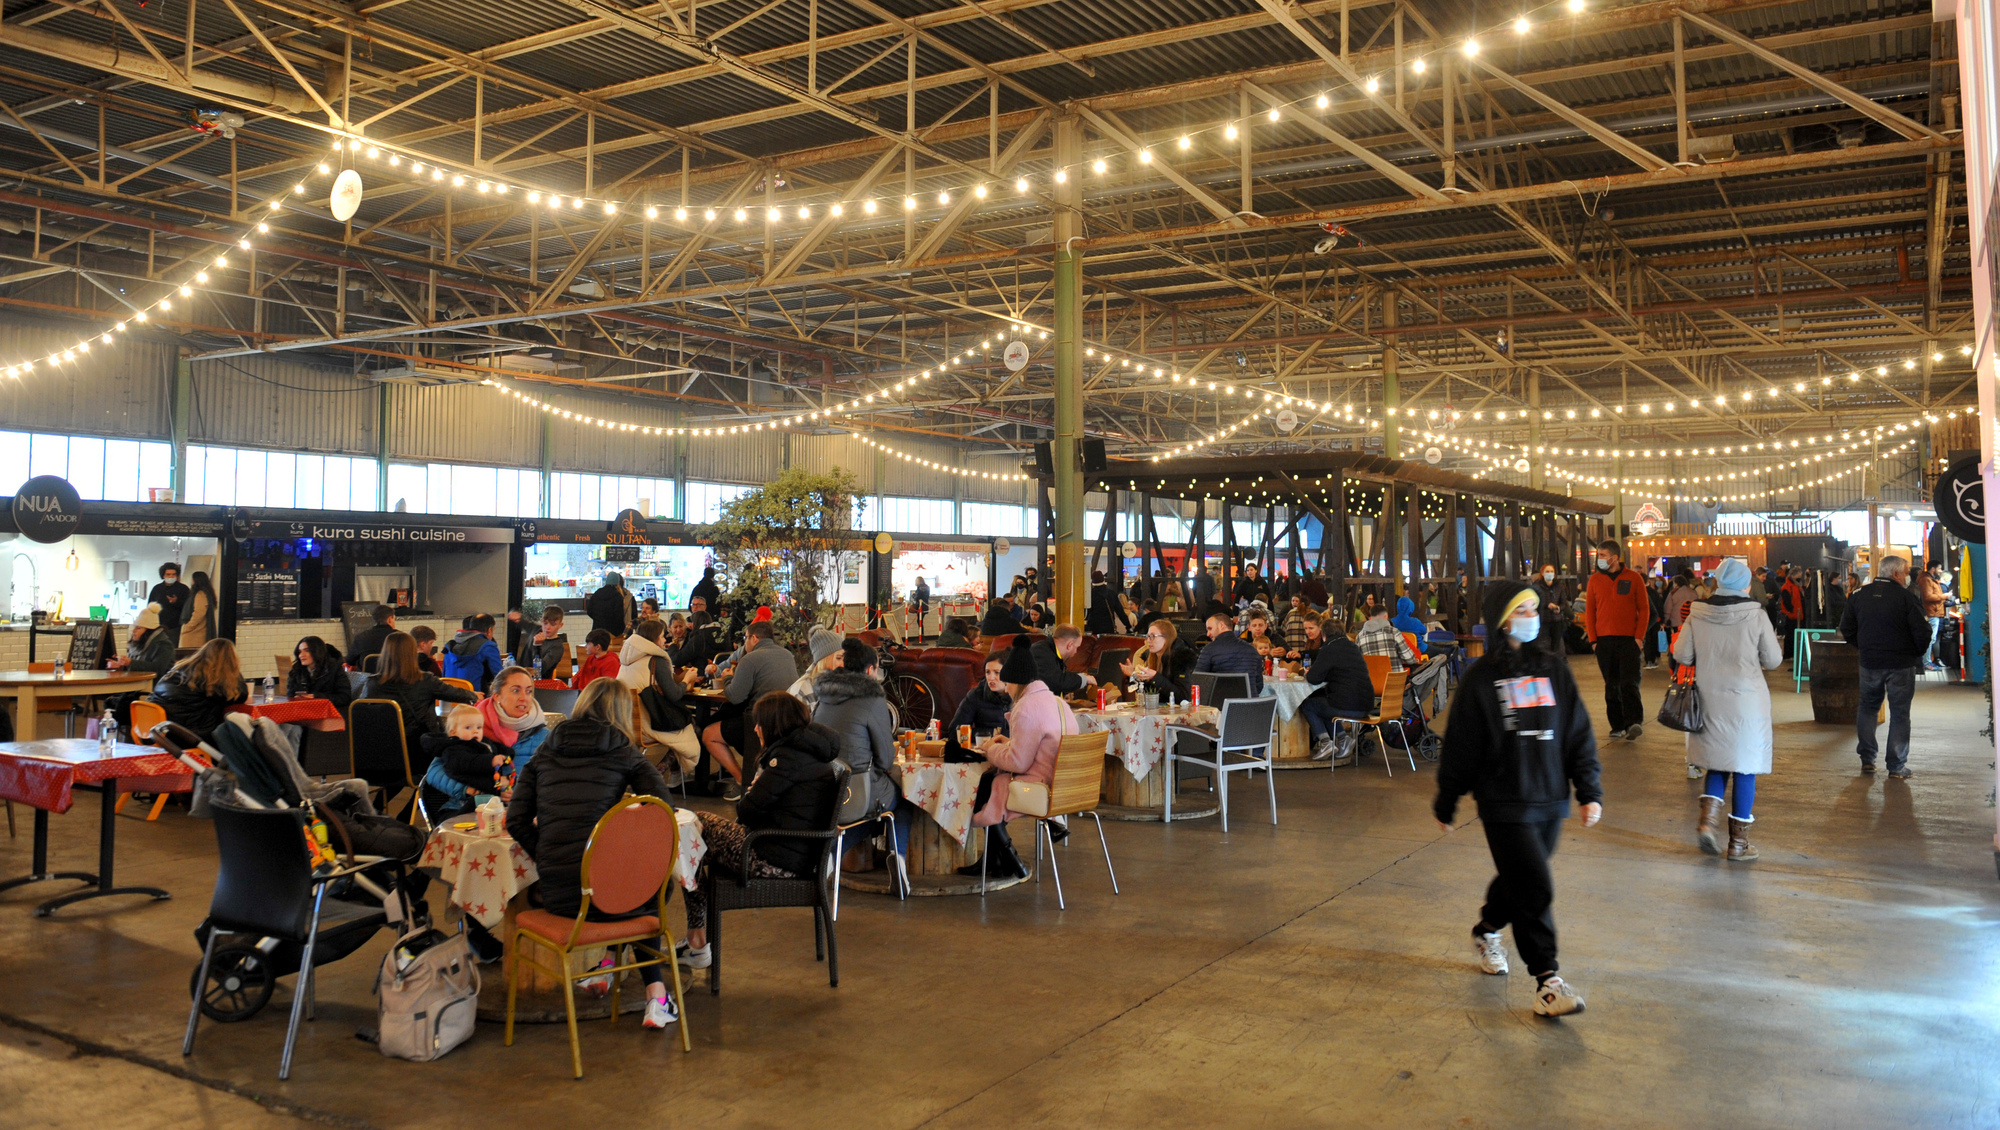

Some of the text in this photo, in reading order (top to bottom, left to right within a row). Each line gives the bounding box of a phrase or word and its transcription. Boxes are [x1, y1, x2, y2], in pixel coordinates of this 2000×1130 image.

[19, 494, 62, 513] NUA
[44, 514, 78, 523] ASADOR
[313, 525, 466, 542] kura sushi cuisine
[575, 534, 591, 542] Fresh
[606, 533, 647, 545] SULTAN
